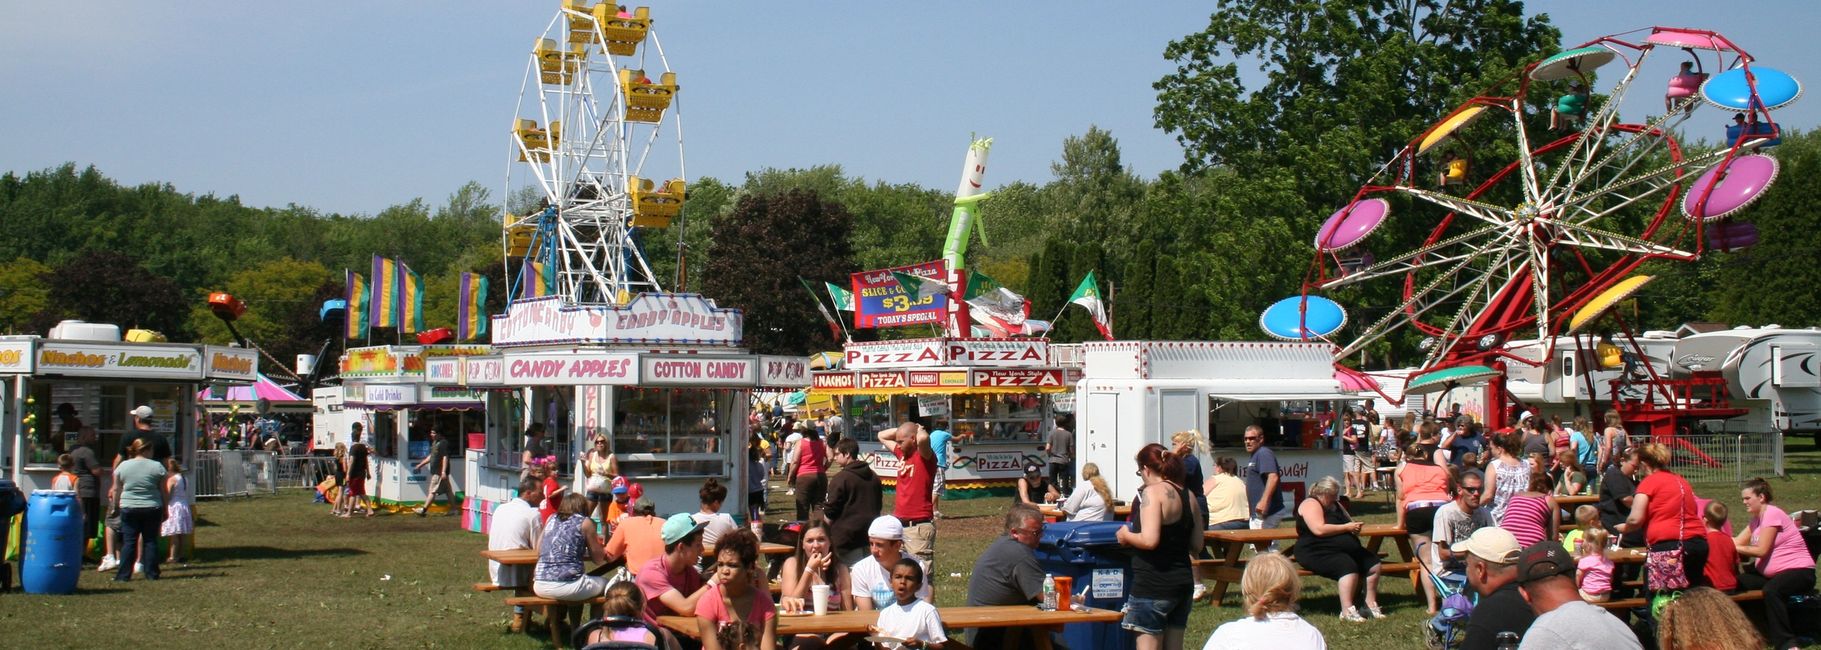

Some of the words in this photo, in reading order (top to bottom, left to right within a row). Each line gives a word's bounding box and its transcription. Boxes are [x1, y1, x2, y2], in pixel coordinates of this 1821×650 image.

[880, 271, 896, 284] Yor
[861, 287, 888, 298] SLICE
[615, 309, 668, 330] CANDY
[670, 309, 726, 332] APPLES
[877, 314, 906, 325] TODAY'S
[907, 311, 937, 322] SPECIAL
[40, 350, 107, 368] Nachos
[117, 352, 192, 369] Lemonade
[846, 346, 940, 364] PIZZA
[950, 345, 1042, 361] PIZZA
[211, 352, 252, 374] Nachos
[510, 359, 566, 378] CANDY
[568, 358, 631, 378] APPLES
[654, 361, 702, 379] COTTON
[706, 361, 746, 379] CANDY
[819, 375, 852, 387] NACHOS
[862, 373, 906, 388] PIZZA
[974, 371, 1060, 387] PIZZA
[875, 456, 900, 467] PIZZ
[1279, 462, 1309, 478] OUGH
